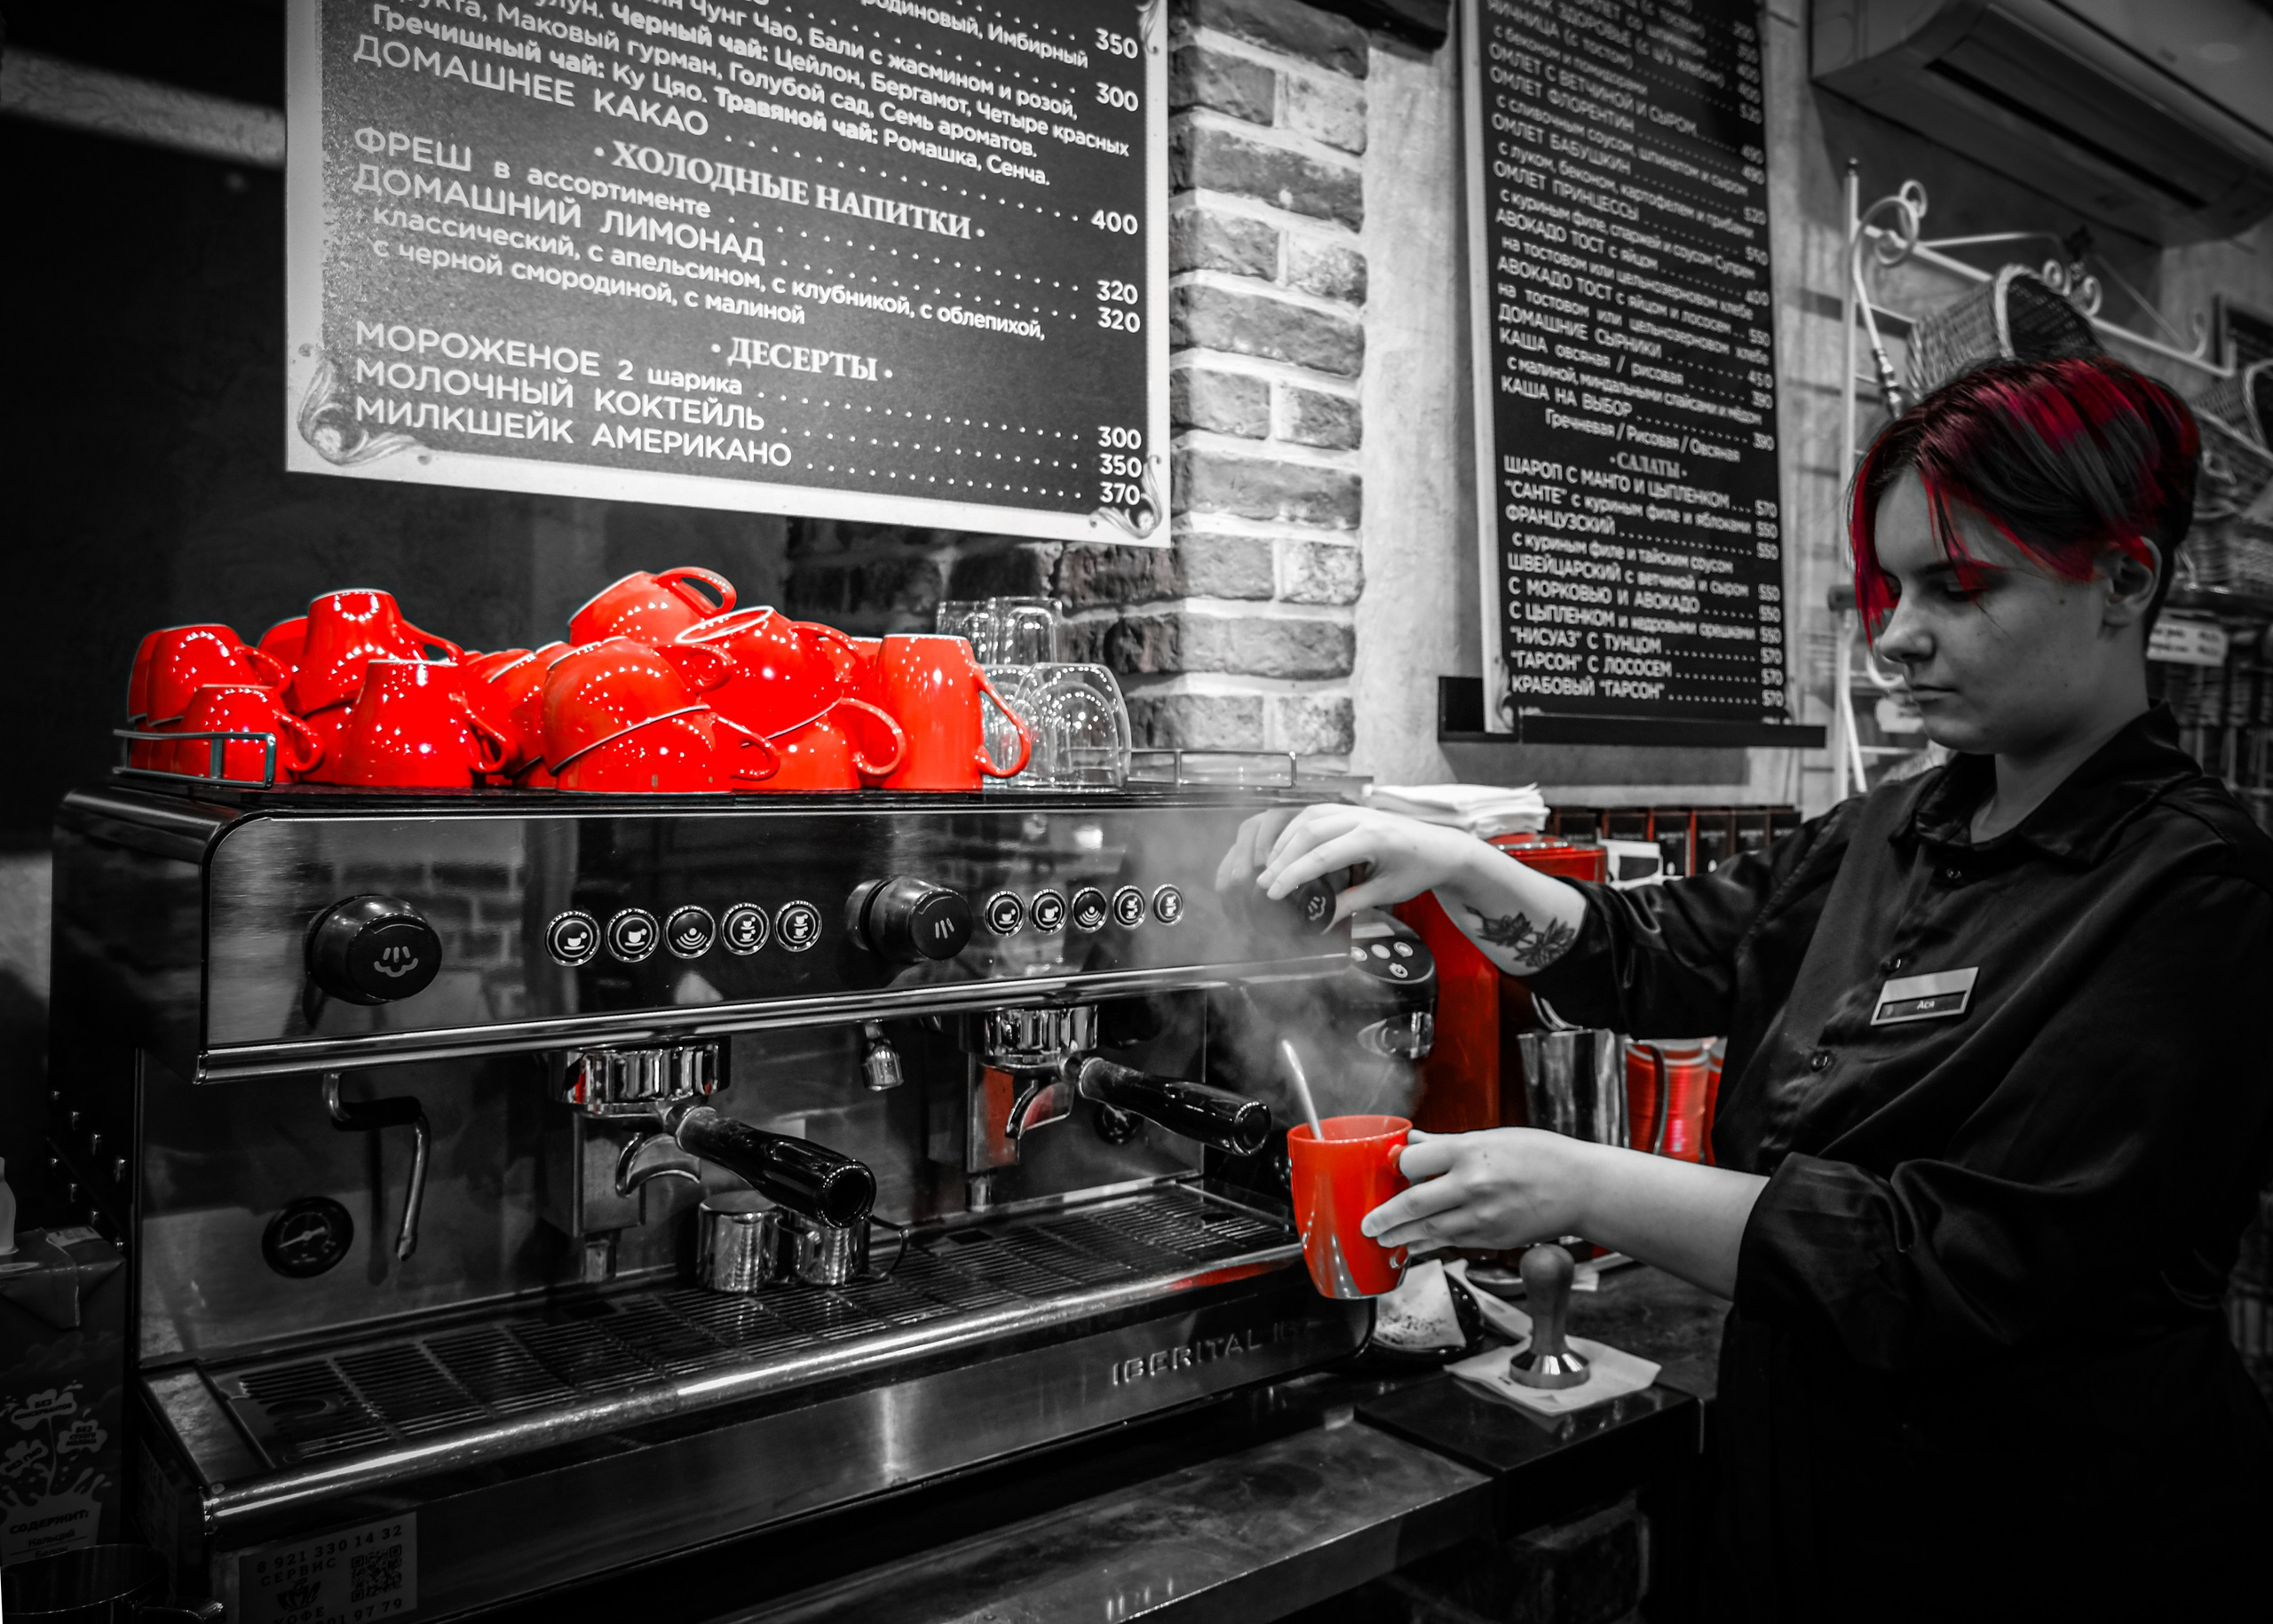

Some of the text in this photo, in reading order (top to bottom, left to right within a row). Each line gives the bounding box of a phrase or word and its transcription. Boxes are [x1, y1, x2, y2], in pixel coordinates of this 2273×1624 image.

[690, 0, 1078, 121] Чунг Чао, Бали с жасмином и розой,
[987, 22, 1089, 68] Имбирный
[1096, 28, 1138, 59] 350
[373, 4, 1050, 186] Гречишный чай: Ку Цяо. Травяной чай: Ромашка, Сенча.
[497, 3, 620, 52] Маковый
[627, 40, 723, 81] гурман,
[730, 61, 826, 105] Голубой
[830, 91, 875, 119] сад,
[879, 101, 934, 132] Семь
[937, 119, 1038, 158] ароматов.
[612, 2, 712, 48] Черный
[717, 34, 769, 62] чай:
[774, 45, 866, 90] Цейлон,
[871, 71, 972, 117] Бергамот,
[976, 99, 1049, 137] Четыре
[1052, 123, 1130, 157] красных
[1096, 82, 1138, 112] 300
[353, 34, 1138, 235] ДОМАШНЕЕ КАКАО 400
[611, 139, 971, 240] ХОЛОДНЫЕ НАПИТКИ
[354, 126, 1138, 305] ФРЕШ в ассортименте 320
[1495, 208, 1567, 243] АВОКАДО
[1570, 230, 1605, 254] ТОСТ
[352, 162, 1141, 334] ДОМАШНИЙ ЛИМОНАД 320
[1501, 235, 1588, 272] на тостовом
[373, 207, 1045, 341] классический, с апельсином, с клубникой, с облепихой,
[373, 240, 805, 325] с черной смородиной, с малиной
[1497, 255, 1572, 290] АВОКАДО
[1575, 276, 1612, 301] ТОСТ
[1497, 282, 1589, 318] на тостовом
[1498, 303, 1588, 341] ДОМАШНИЕ
[1594, 328, 1662, 360] СЫРНИКИ
[1499, 327, 1548, 354] КАША
[727, 337, 878, 382] ДЕСЕРТЫ
[357, 321, 1142, 450] МОРОЖЕНОЕ 2 шарика 300
[1501, 375, 1633, 417] КАША НА ВЫБОР
[357, 358, 1143, 478] МОЛОЧНЫЙ КОКТЕЙЛЬ 350
[357, 396, 1141, 506] МИЛКШЕЙК АМЕРИКАНО 370
[1617, 451, 1680, 479] САЛАТЫ
[1565, 465, 1578, 484] С
[1580, 468, 1631, 493] МАНГО
[1505, 503, 1615, 536] ФРАНЦУЗСКИЙ
[1508, 551, 1621, 582] ШВЕЙЦАРСКИЙ
[1508, 576, 1521, 595] С
[1525, 578, 1612, 605] МОРКОВЬЮ
[1616, 588, 1629, 606] И
[1634, 590, 1700, 614] АВОКАДО
[1509, 600, 1522, 620] С
[1525, 602, 1615, 628] ЦЫПЛЕНКОМ
[1586, 631, 1599, 650] С
[1603, 632, 1662, 655] ТУНЦОМ
[1587, 654, 1599, 673] С
[1603, 656, 1673, 677] ЛОСОСЕМ
[1511, 674, 1596, 696] КРАБОВЫЙ
[1113, 1328, 1262, 1386] IBERITAL
[10, 1509, 89, 1534] СОДЕРЖИТ:
[28, 1528, 75, 1547] Кальций
[257, 1525, 402, 1573] 8 921 330 14 32
[261, 1557, 337, 1587] СЕРВИС
[355, 1605, 375, 1620] 97
[382, 1598, 401, 1612] 79
